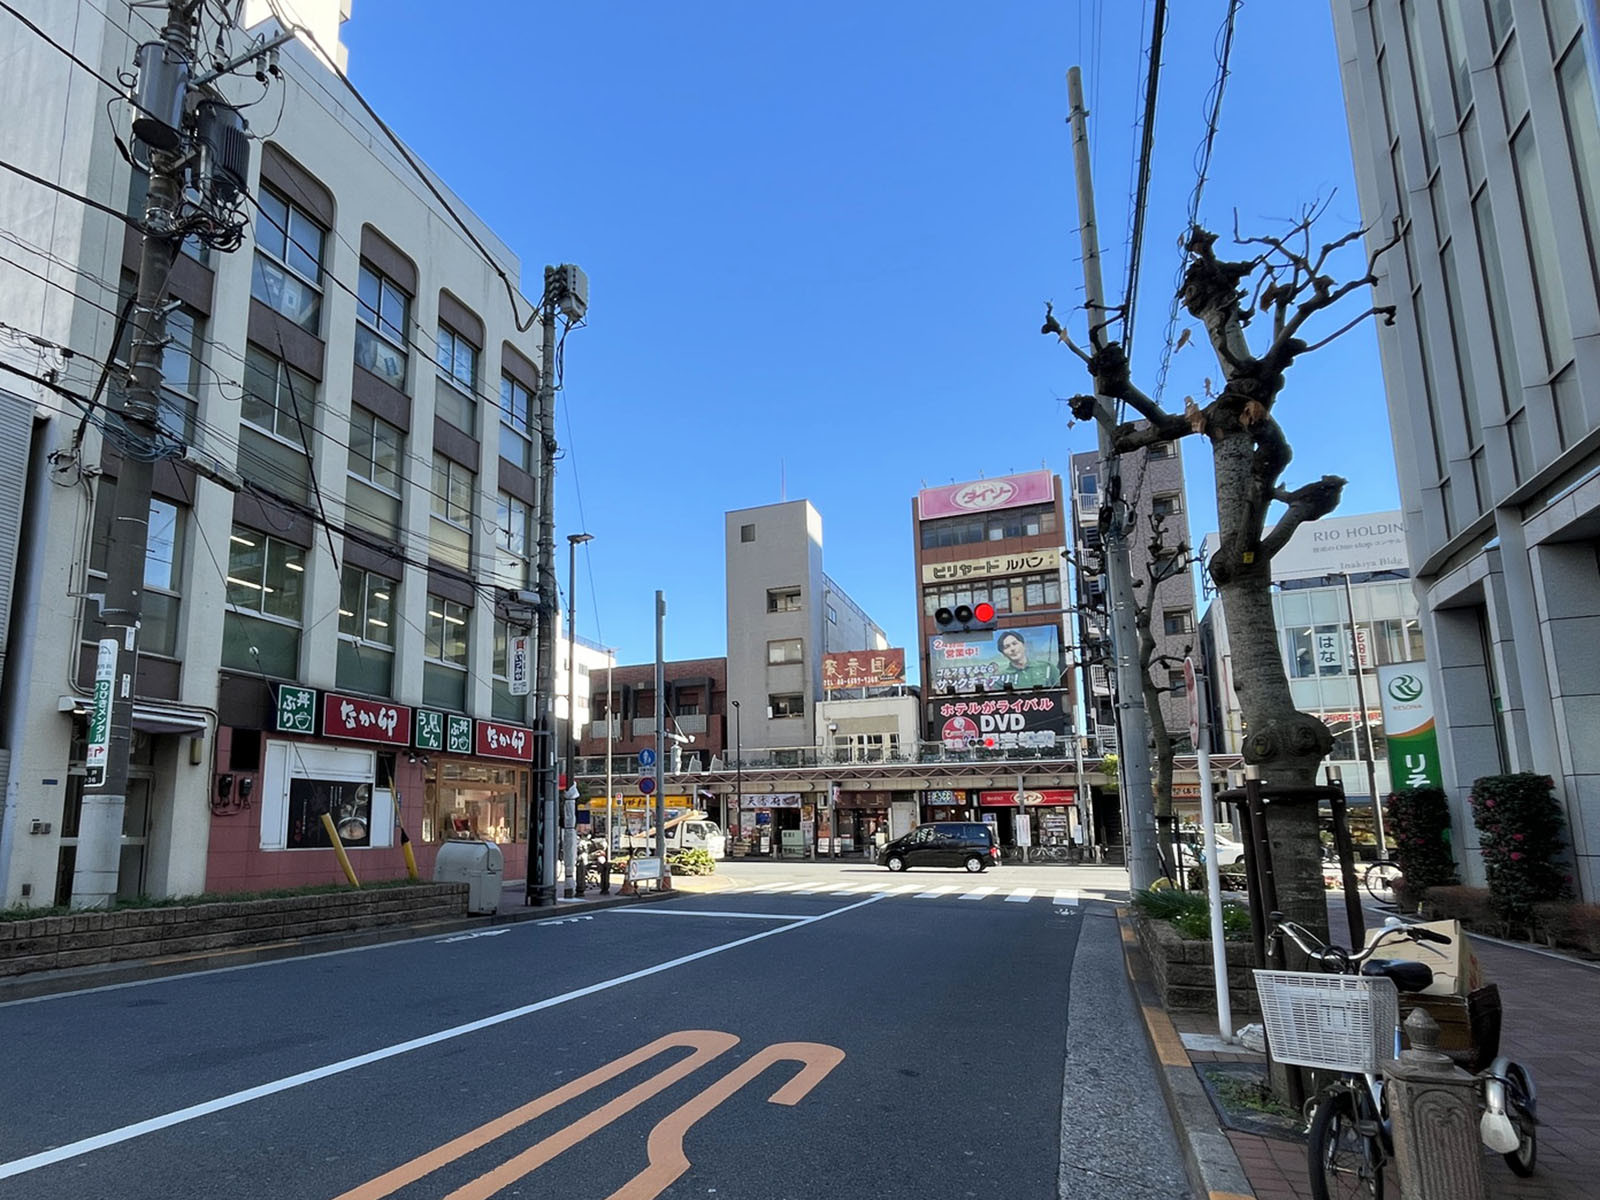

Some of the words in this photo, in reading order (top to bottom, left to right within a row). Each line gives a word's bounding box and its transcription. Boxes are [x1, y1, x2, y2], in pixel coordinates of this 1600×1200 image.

[963, 487, 1011, 503] ダイソー
[1313, 530, 1340, 541] RIO
[1346, 522, 1407, 538] HOLDIN
[933, 560, 1000, 579] ビリヤード
[1318, 636, 1336, 663] はな
[941, 698, 1054, 716] ホテルがライバル
[340, 700, 399, 737] なか卯
[980, 714, 1026, 732] DVD
[487, 726, 525, 755] なか卯
